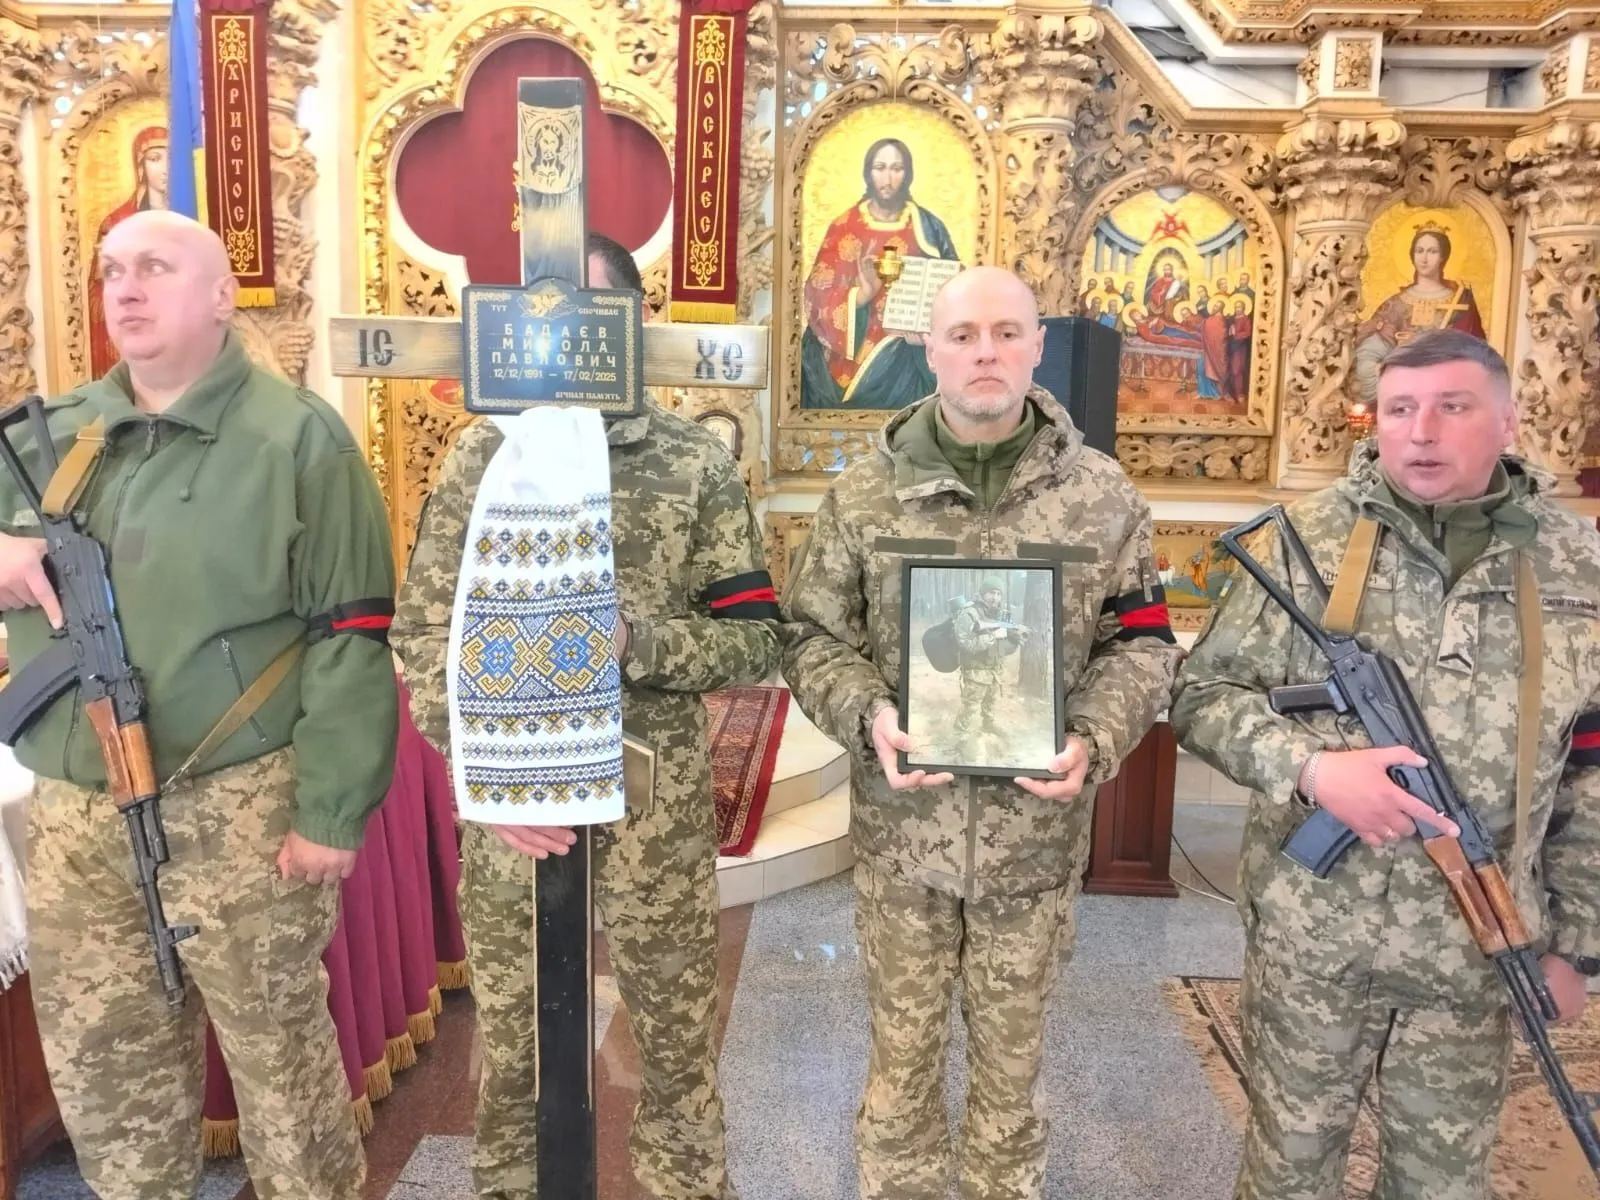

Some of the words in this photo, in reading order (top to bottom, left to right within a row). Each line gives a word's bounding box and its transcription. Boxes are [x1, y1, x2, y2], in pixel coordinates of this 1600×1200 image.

[227, 63, 245, 223] ХРИСТОС
[504, 323, 607, 339] БАДАЄВ
[502, 338, 608, 353] МИОЛА
[491, 351, 616, 367] ПАВЛОВИЧ
[493, 368, 543, 381] 12/12/1991
[563, 369, 617, 383] 17/02/2025
